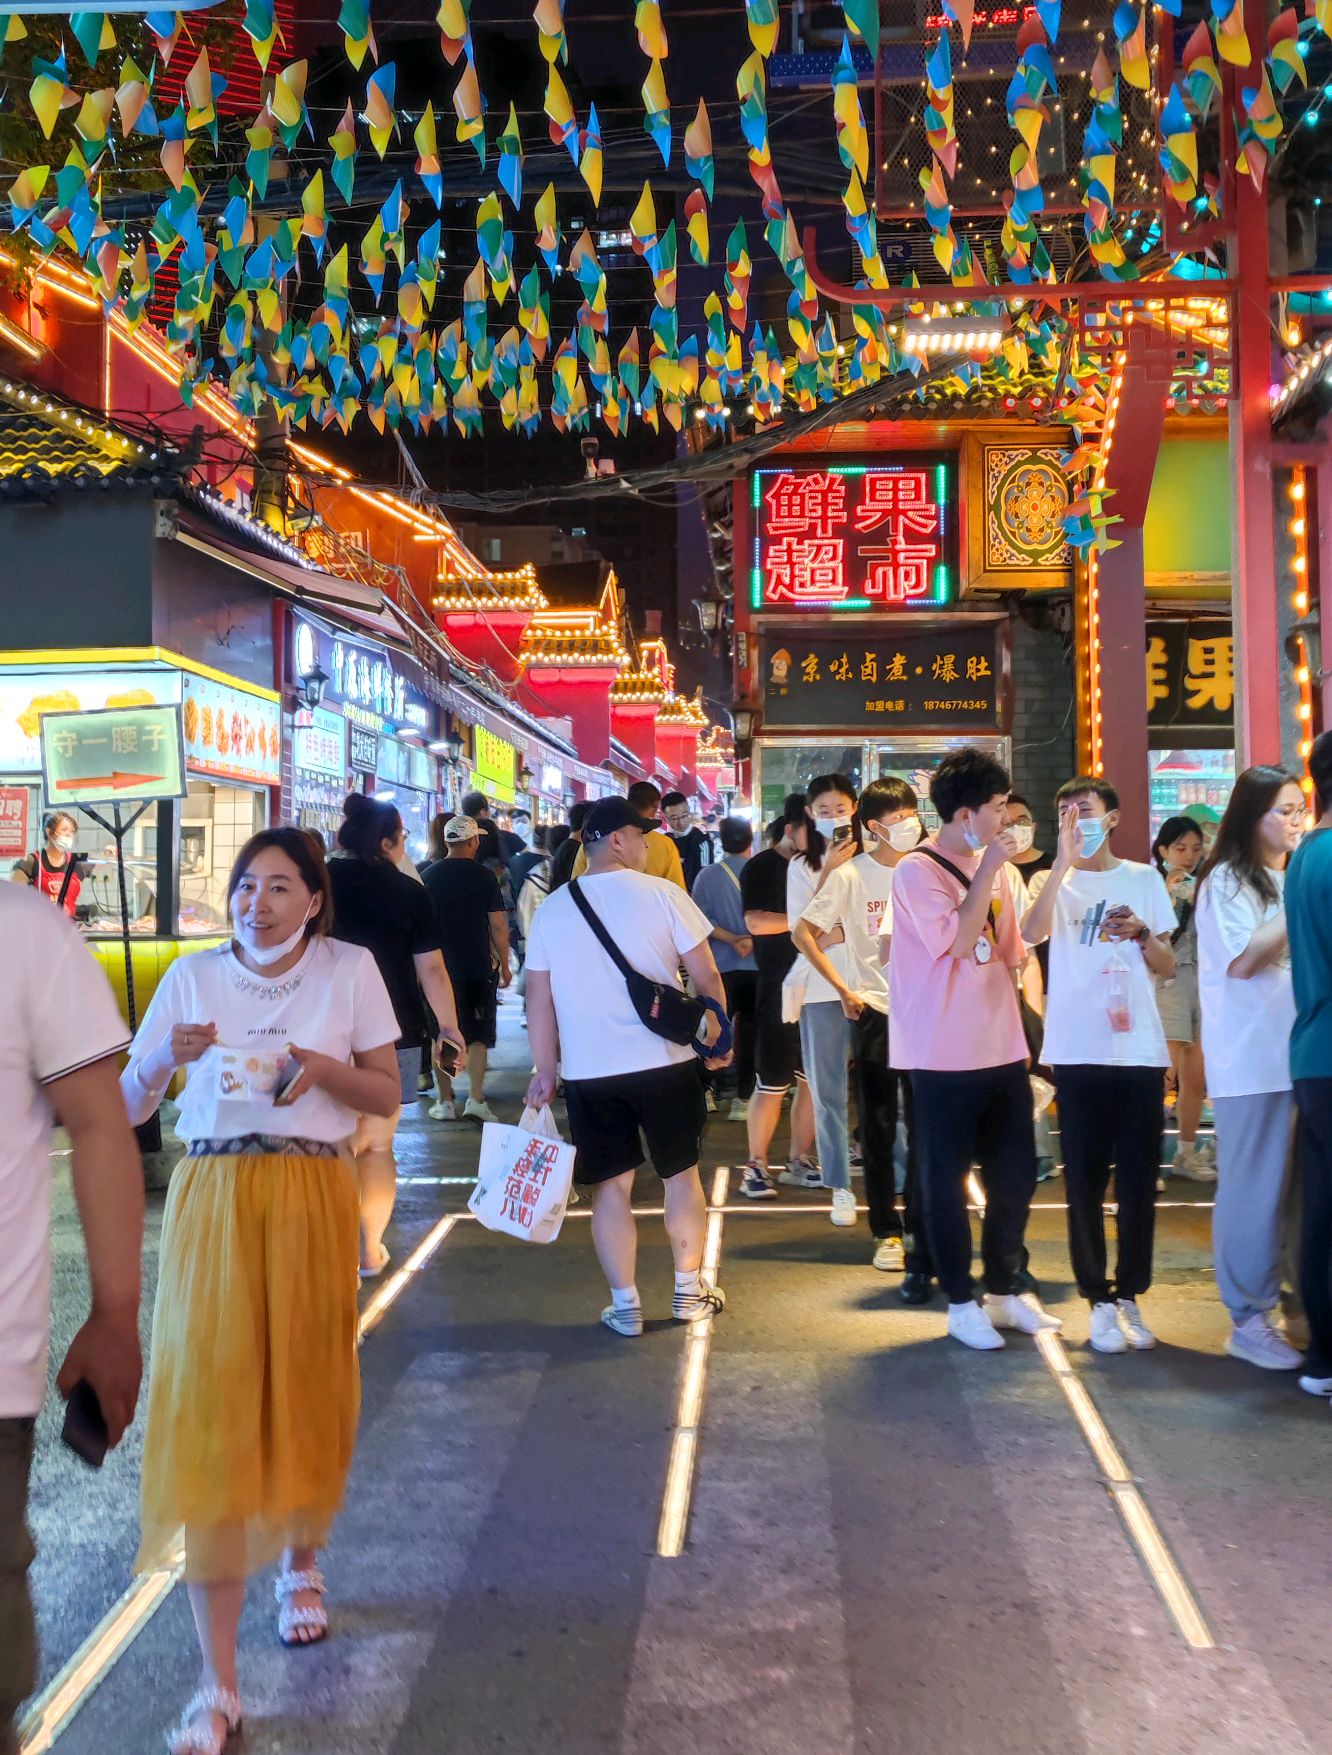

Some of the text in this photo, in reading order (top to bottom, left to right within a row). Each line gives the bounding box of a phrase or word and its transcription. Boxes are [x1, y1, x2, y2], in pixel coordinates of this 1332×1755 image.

[886, 245, 905, 258] R
[765, 472, 939, 537] 鲜果
[765, 536, 939, 601] 超市
[923, 700, 988, 711] 18746774345
[51, 723, 168, 758] 守一腰子
